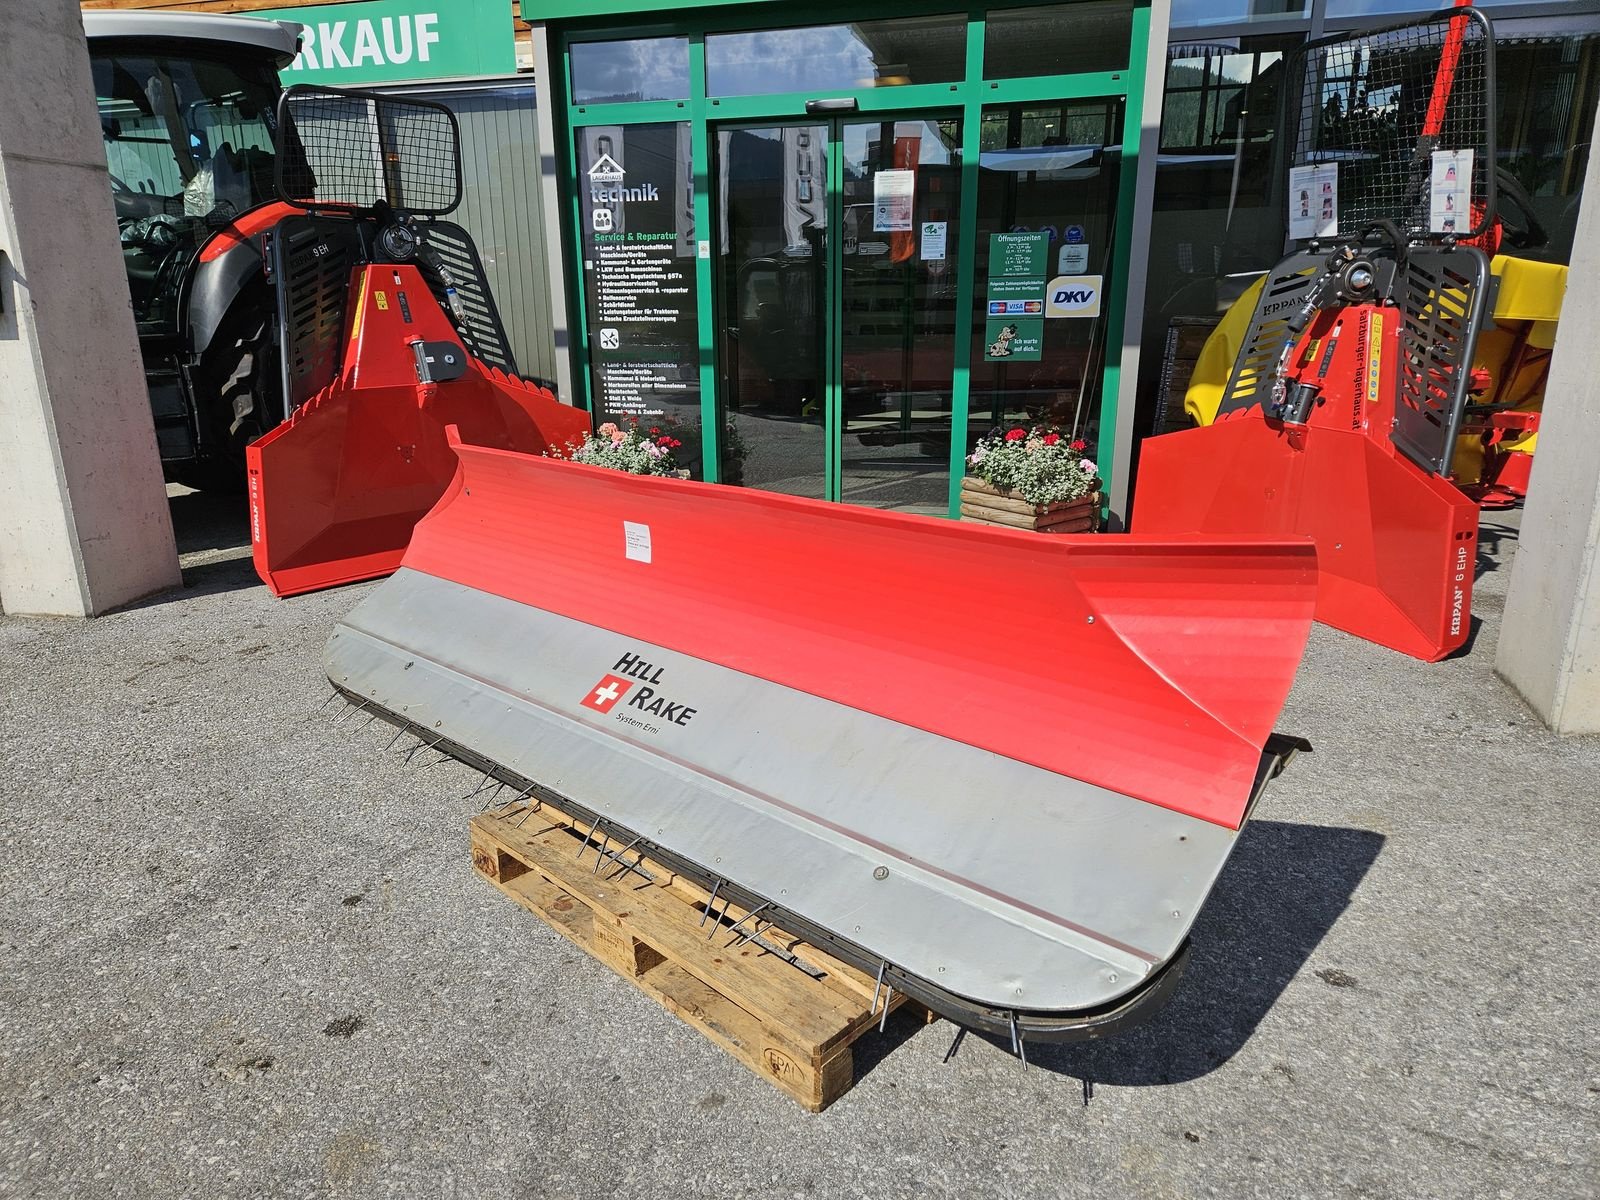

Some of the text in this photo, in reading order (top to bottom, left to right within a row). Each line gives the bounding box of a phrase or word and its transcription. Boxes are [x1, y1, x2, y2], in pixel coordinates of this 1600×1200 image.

[279, 13, 440, 71] RKAUF
[591, 184, 659, 203] technik
[595, 233, 625, 241] Service
[637, 231, 678, 242] Reparatur
[998, 235, 1042, 244] Öffnungszeiten
[312, 247, 320, 257] 9
[319, 243, 330, 255] EH
[637, 259, 672, 267] Gartengeräte
[1053, 290, 1095, 304] DKV
[623, 315, 677, 323] Ersatzteilversorgung
[1352, 310, 1367, 431] salzburger-lagerhaus.at
[1456, 546, 1467, 571] EHP
[1455, 573, 1465, 582] 6
[612, 651, 665, 686] HILL
[628, 686, 698, 727] RAKE
[615, 712, 661, 735] System Erni
